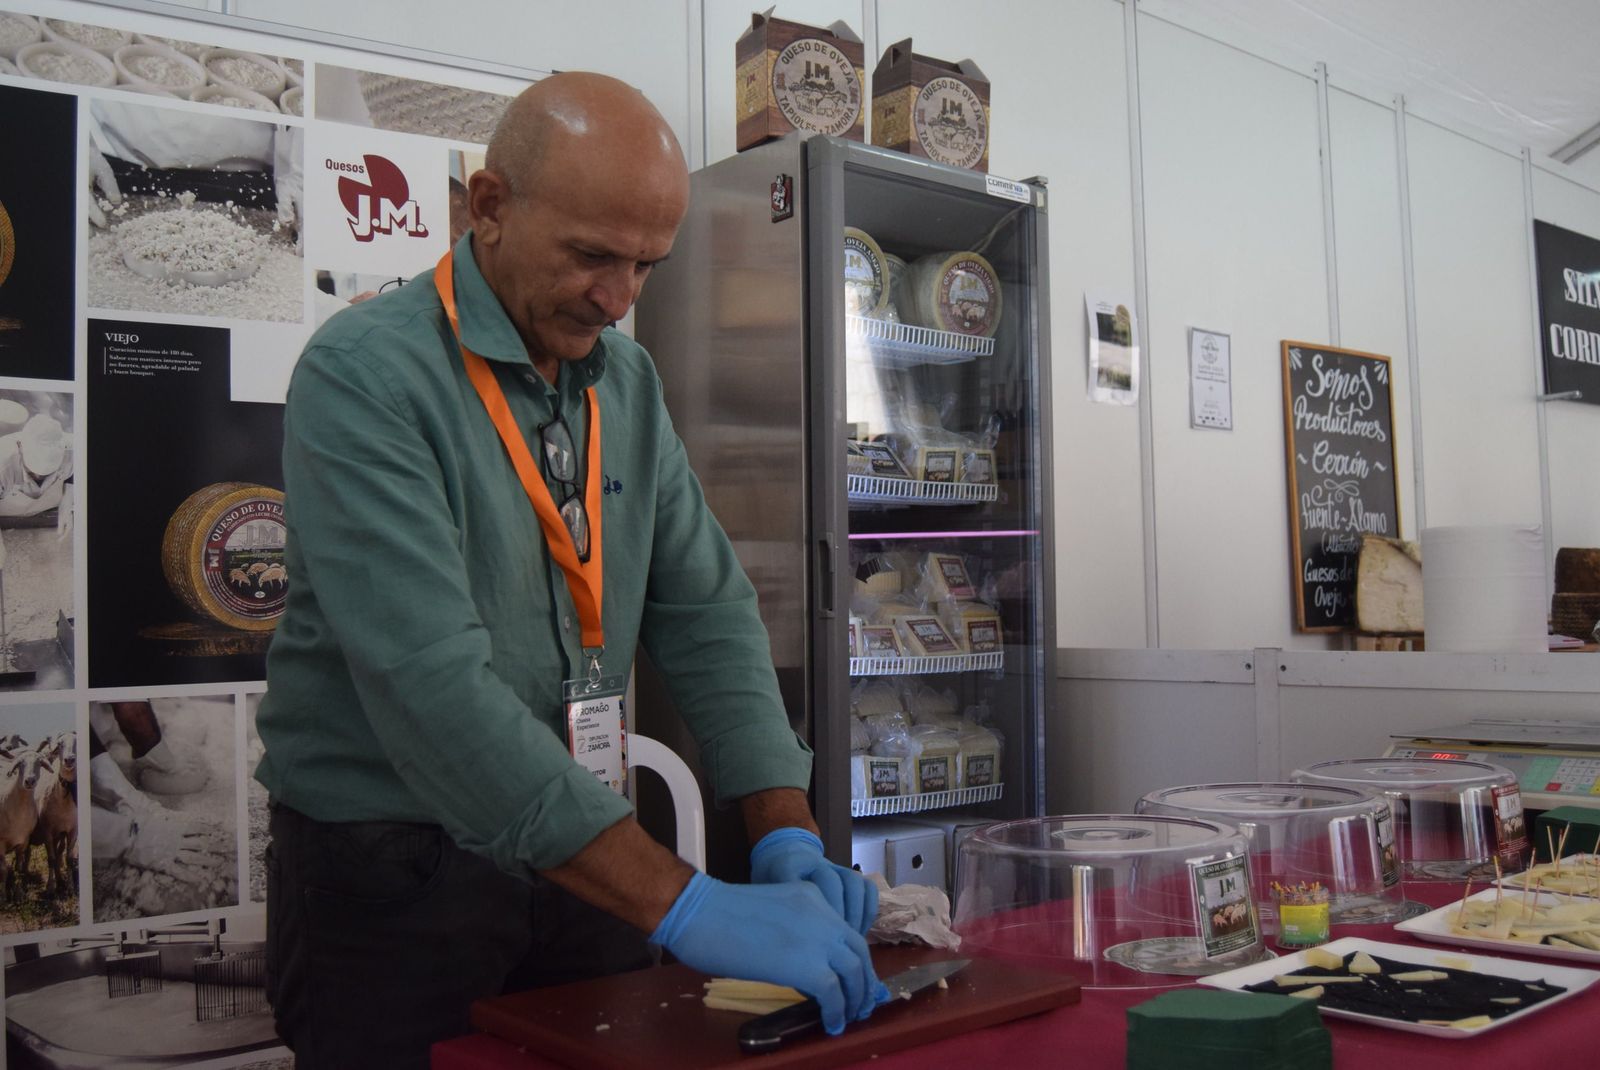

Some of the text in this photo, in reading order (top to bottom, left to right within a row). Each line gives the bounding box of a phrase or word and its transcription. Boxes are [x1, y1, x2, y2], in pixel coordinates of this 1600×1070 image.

[781, 41, 811, 65] QUESO
[814, 42, 828, 55] DE
[829, 50, 855, 86] OVEJA
[803, 60, 833, 82] J.M.
[922, 80, 983, 122] QUESO DE OVEJA
[824, 107, 855, 136] ZAMORA
[325, 158, 365, 174] Quesos
[346, 193, 428, 242] J.M.
[104, 333, 140, 345] VIEJO
[1305, 353, 1374, 410] Somos
[1294, 394, 1386, 442] Productores
[1312, 440, 1369, 479] Cerrón
[211, 511, 239, 542] QUESO
[240, 503, 256, 516] DE
[257, 502, 285, 517] OVEJ
[588, 741, 611, 752] ZAMORA
